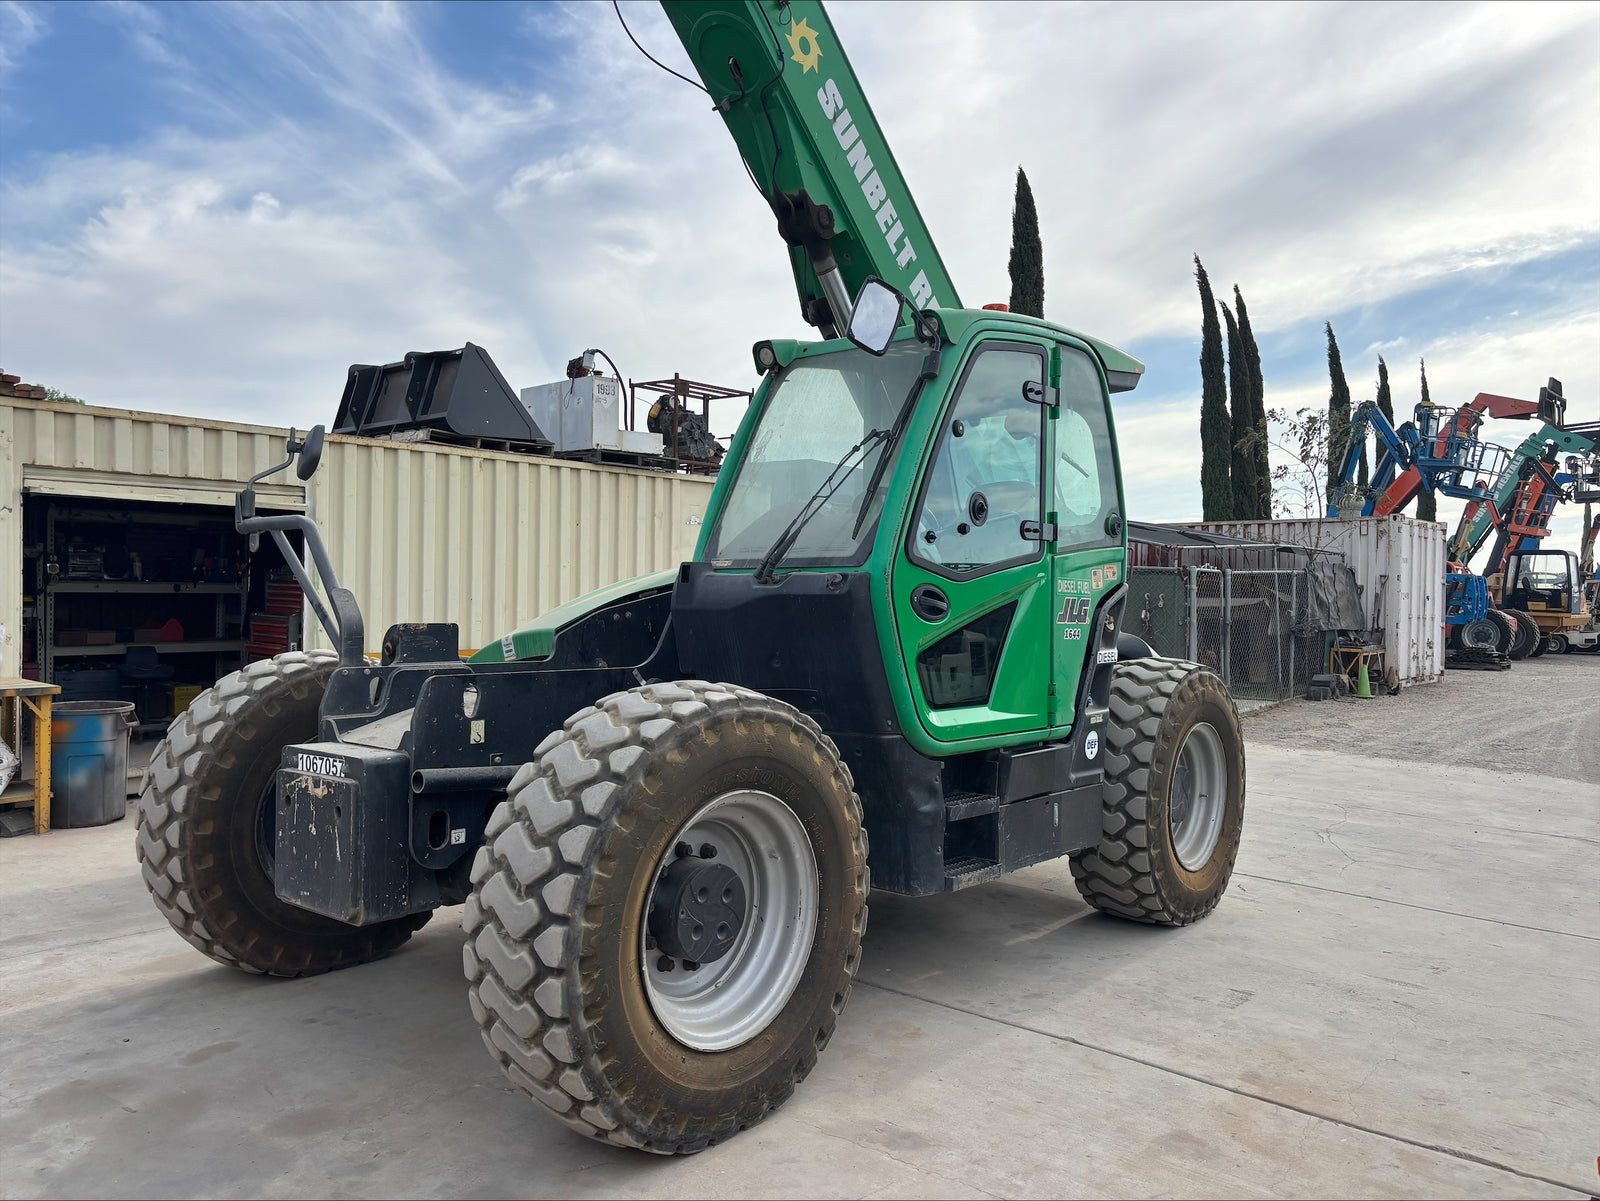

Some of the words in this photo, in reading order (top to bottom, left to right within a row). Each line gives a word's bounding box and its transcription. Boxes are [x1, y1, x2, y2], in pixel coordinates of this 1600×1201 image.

[817, 78, 918, 271] SUNBELT
[1496, 454, 1524, 490] RENTALS
[1057, 579, 1077, 594] DIESEL
[1077, 580, 1091, 594] FUEL
[1056, 596, 1091, 625] JLG
[1063, 628, 1081, 640] 1644
[1098, 651, 1118, 663] DIESEL
[1086, 740, 1098, 750] DEF
[299, 754, 345, 778] 1067057
